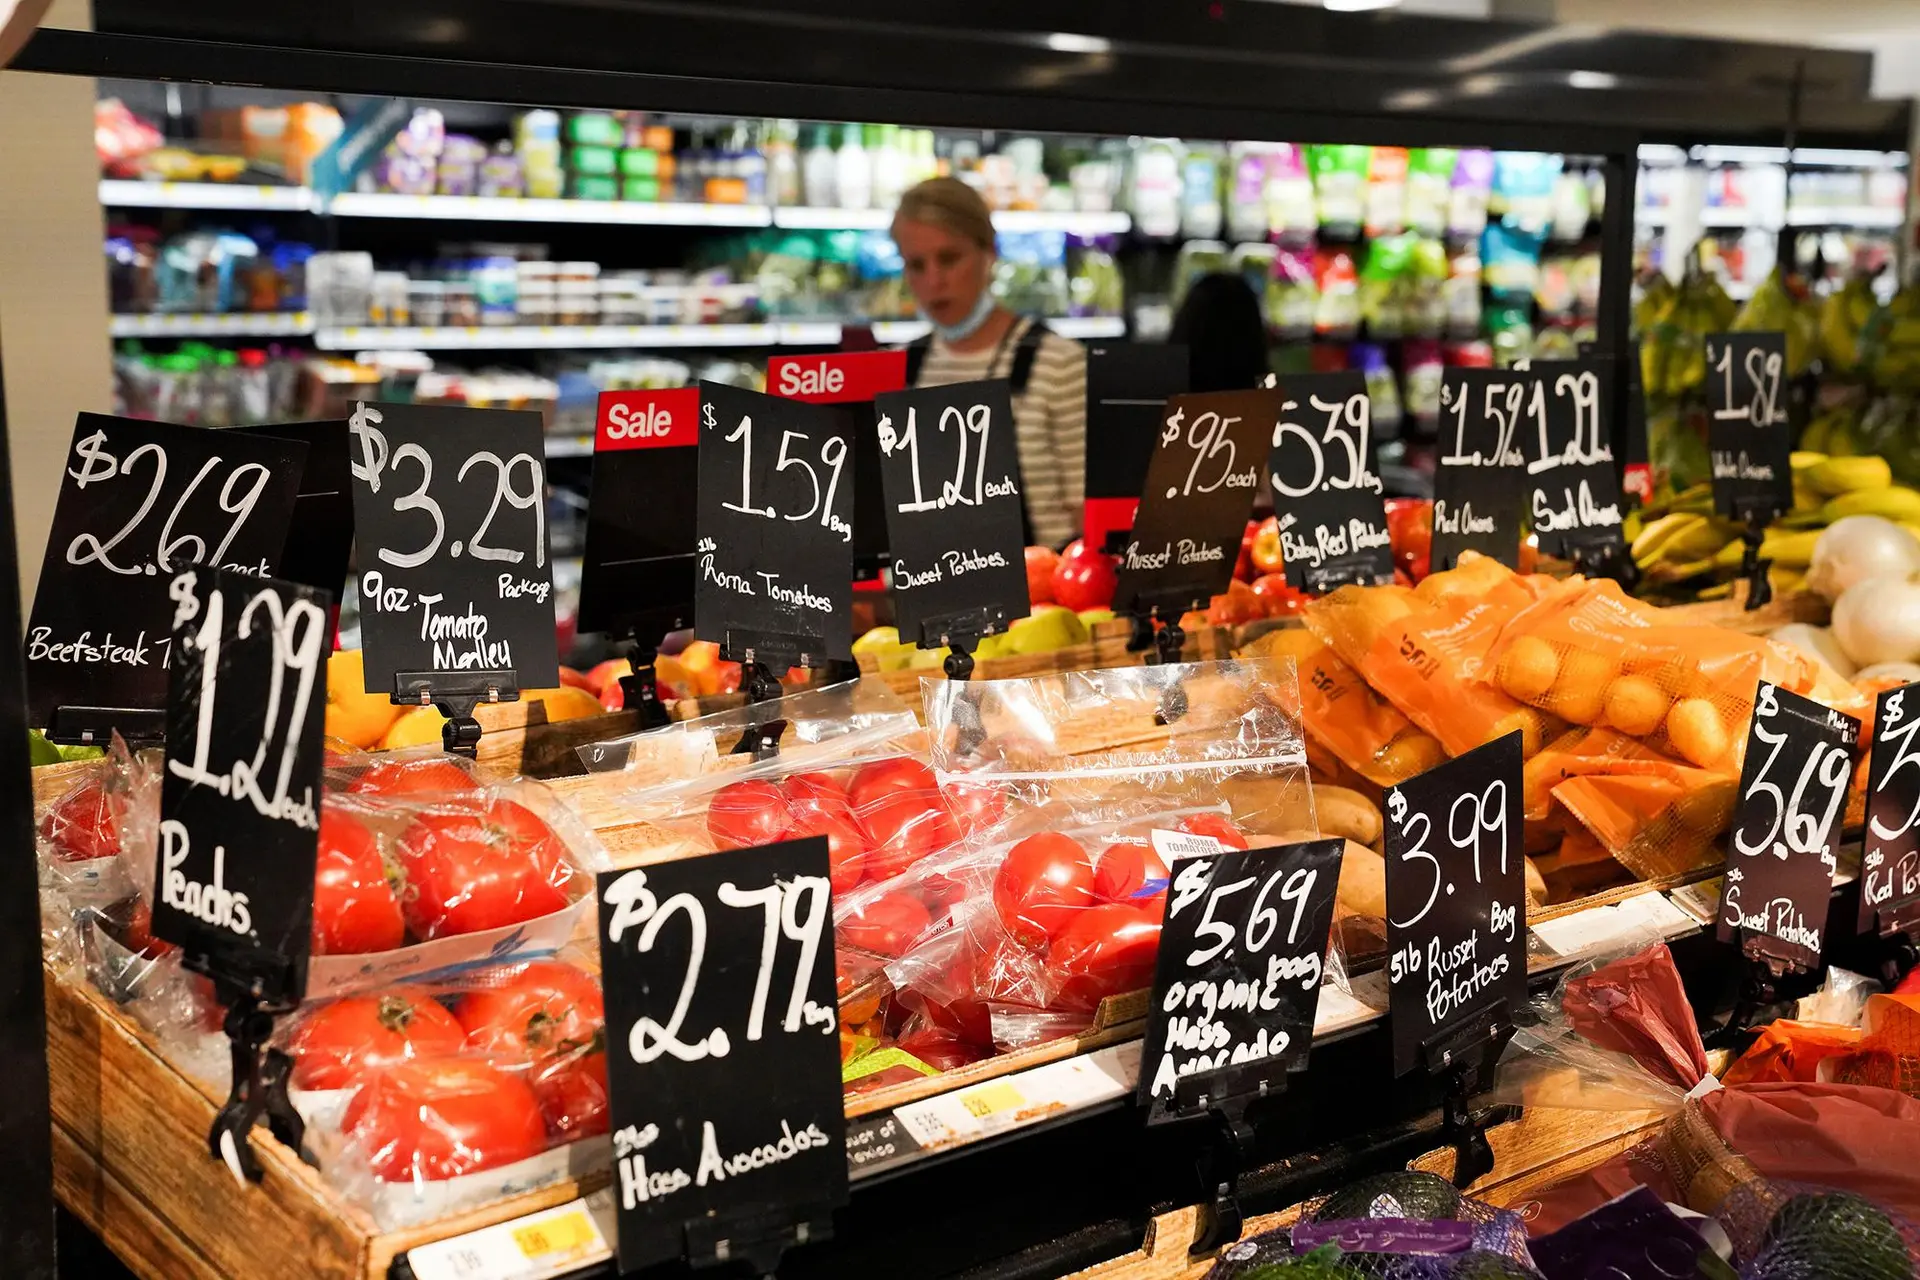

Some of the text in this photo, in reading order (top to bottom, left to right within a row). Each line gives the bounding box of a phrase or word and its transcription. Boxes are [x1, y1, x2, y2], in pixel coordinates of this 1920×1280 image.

[778, 361, 845, 395] Sale
[606, 402, 673, 439] Sale
[702, 402, 852, 542] $1.59 Bag
[876, 403, 1019, 513] $1.29 each
[1225, 465, 1257, 488] each
[348, 401, 545, 569] $3.29
[1125, 541, 1171, 571] Russet
[1280, 531, 1322, 568] Baby
[1315, 524, 1349, 561] Red
[700, 553, 833, 613] Roma Tomatoes
[895, 559, 943, 590] Sweet
[418, 592, 489, 641] Tomato
[28, 626, 149, 667] Beefsteak
[168, 571, 326, 820] $1.29
[1735, 683, 1851, 861] $3.69
[1185, 836, 1218, 848] ROMA
[1387, 779, 1508, 929] $3.99
[1490, 900, 1516, 942] Bag
[1725, 885, 1771, 933] Sweet
[1865, 867, 1894, 906] Red
[1169, 858, 1322, 990] $5.69 bag
[603, 869, 831, 1064] $2.79
[1389, 941, 1422, 984] 5lb
[1426, 952, 1510, 1025] Potatoes
[1164, 1015, 1232, 1053] Hass
[1150, 1027, 1291, 1098] Avocado
[618, 1153, 692, 1211] Hass
[696, 1118, 831, 1187] Avocados
